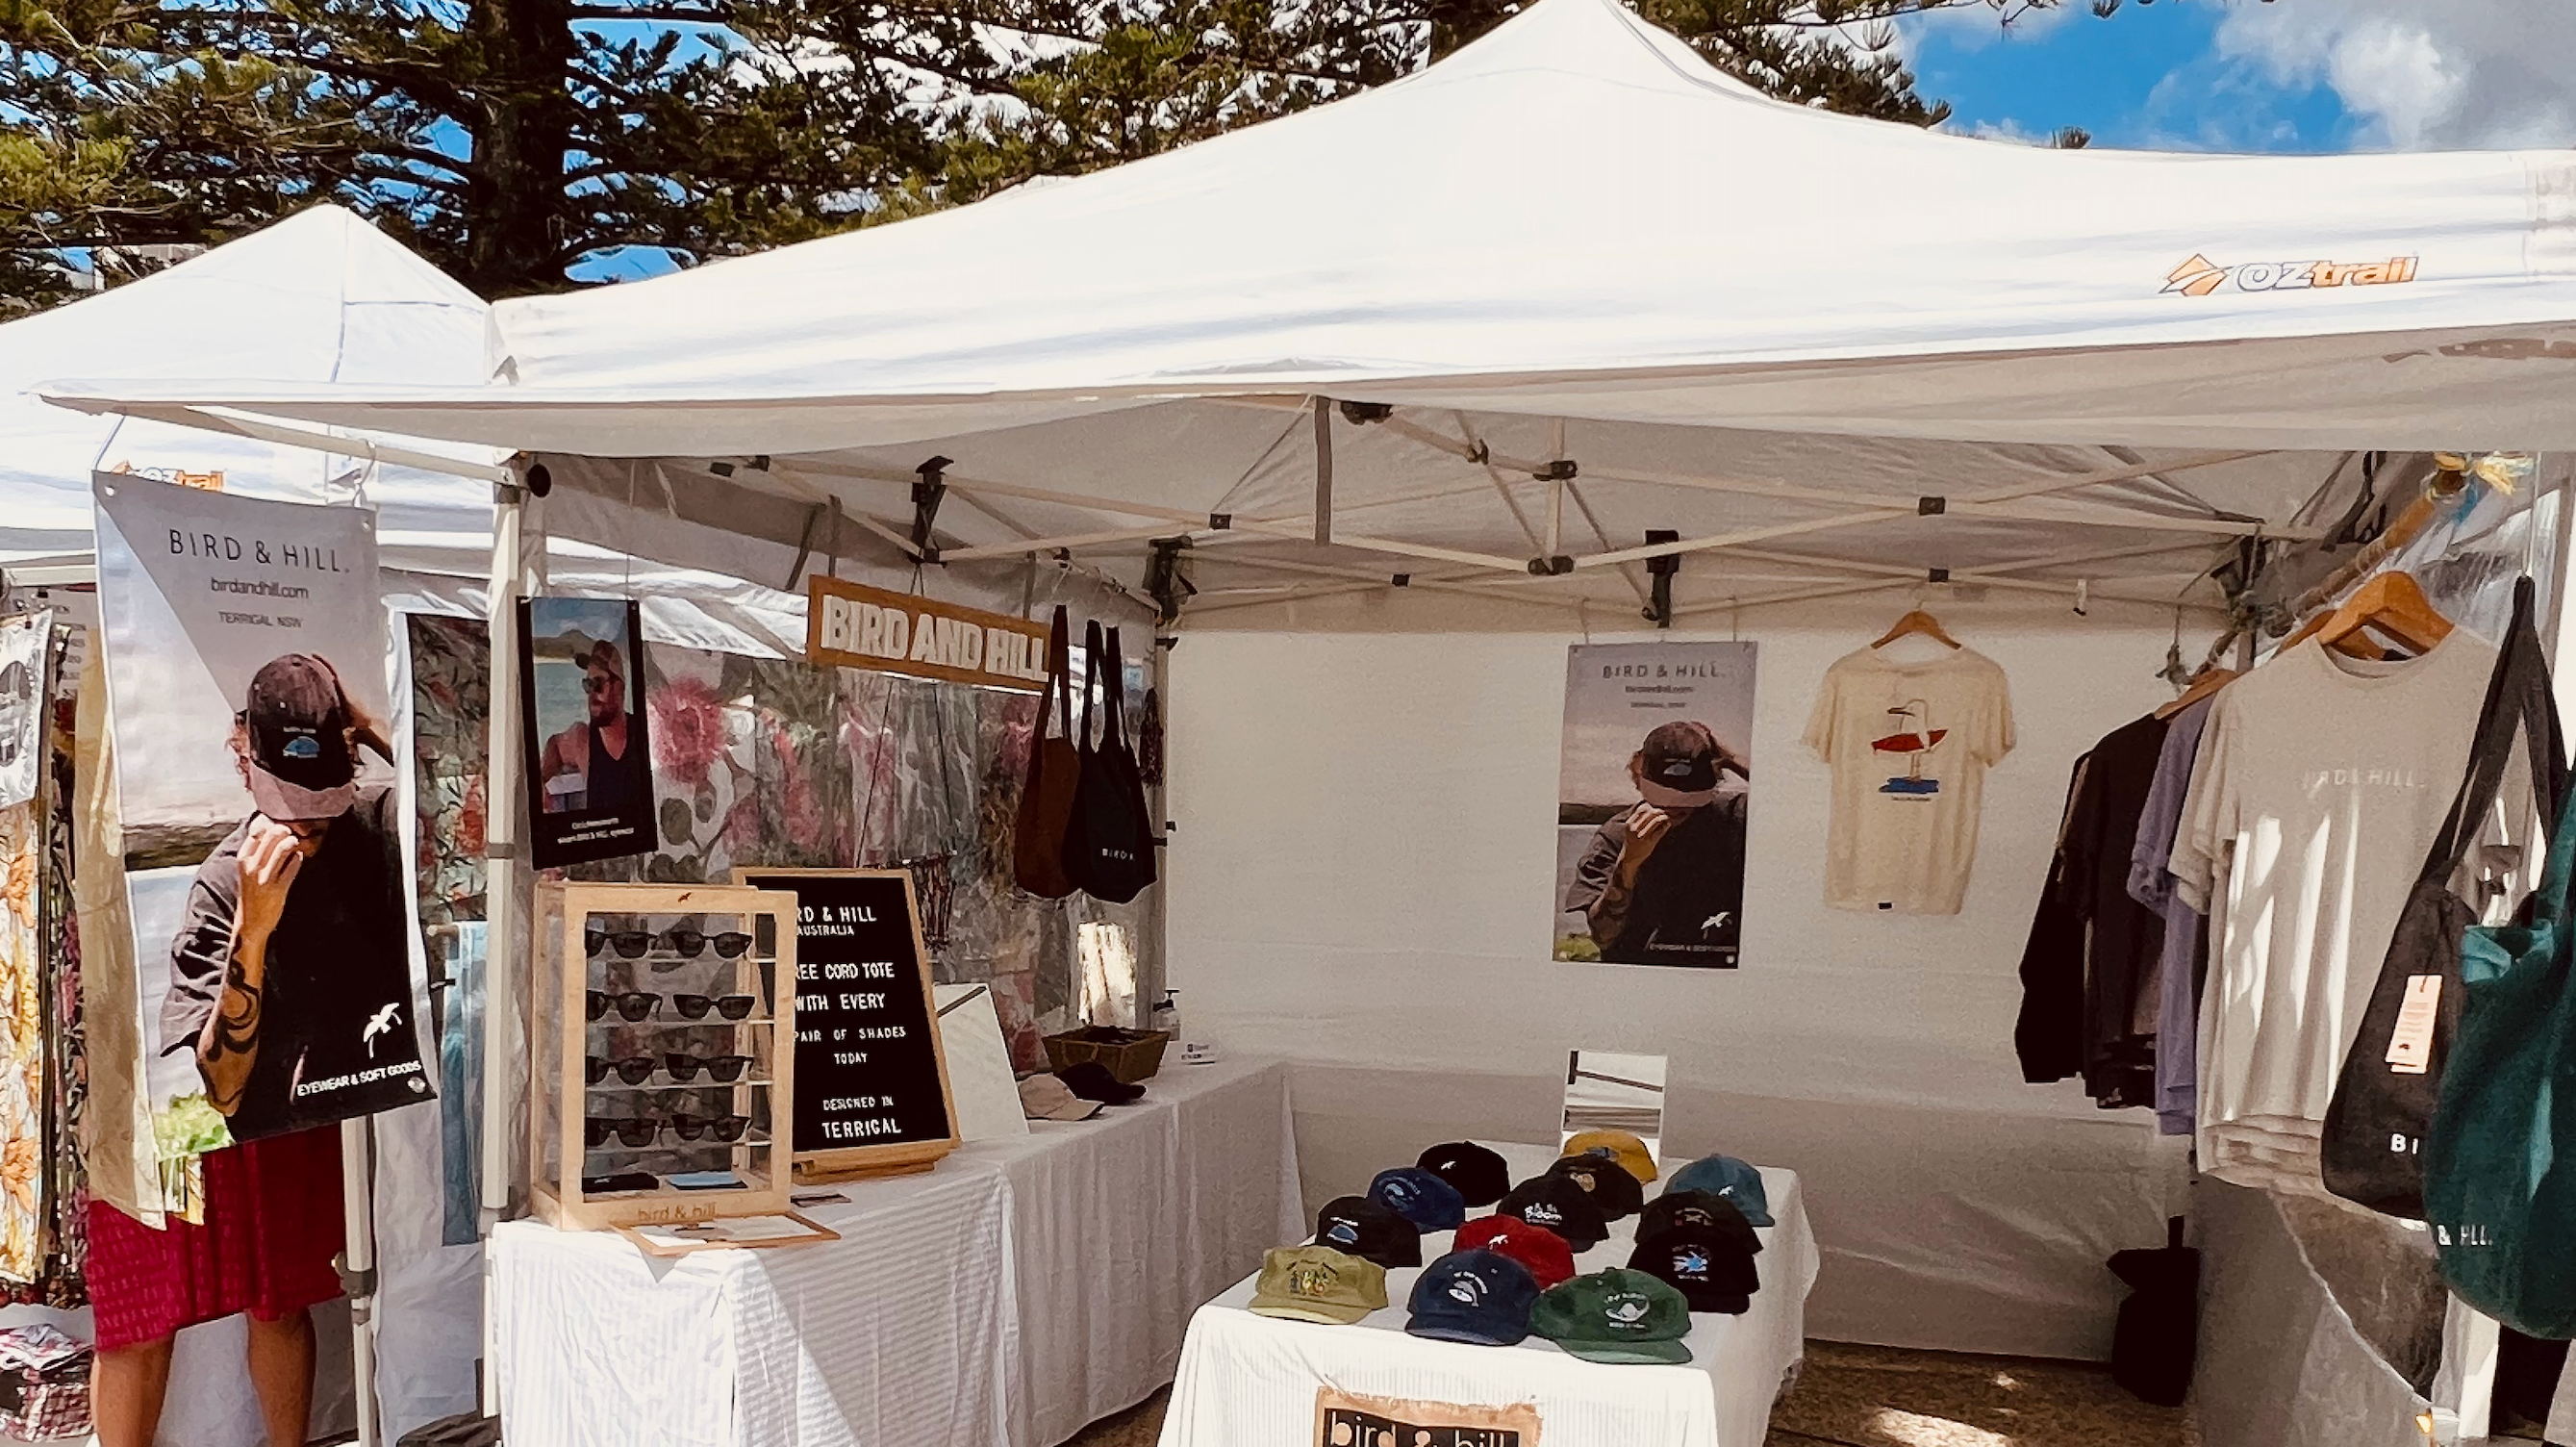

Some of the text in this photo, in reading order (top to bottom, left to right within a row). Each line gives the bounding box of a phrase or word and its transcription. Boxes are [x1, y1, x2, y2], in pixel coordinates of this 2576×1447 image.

[169, 529, 241, 561] BIRD
[256, 541, 271, 564] &
[211, 577, 309, 599] birdandhill.com
[218, 610, 273, 627] TERRIGAL
[821, 595, 1049, 683] BIRD AND HILL
[1603, 665, 1648, 678] BIRD
[1656, 664, 1668, 677] &
[822, 906, 833, 922] &
[839, 906, 877, 923] HILL
[796, 925, 855, 936] AUSTRALIA
[824, 963, 859, 979] CORD
[862, 962, 896, 978] TOTE
[796, 993, 886, 1011] WITH EVERY
[833, 1028, 847, 1041] OF
[858, 1026, 906, 1040] SHADES
[833, 1052, 868, 1065] TODAY
[297, 1059, 422, 1097] EYEWEAR & SOFT GOODS
[822, 1095, 894, 1111] DESIGNED IN
[821, 1117, 902, 1139] TERRIGAL
[2390, 1133, 2419, 1155] BI
[638, 1201, 717, 1222] bird & hill
[2437, 1224, 2452, 1246] &
